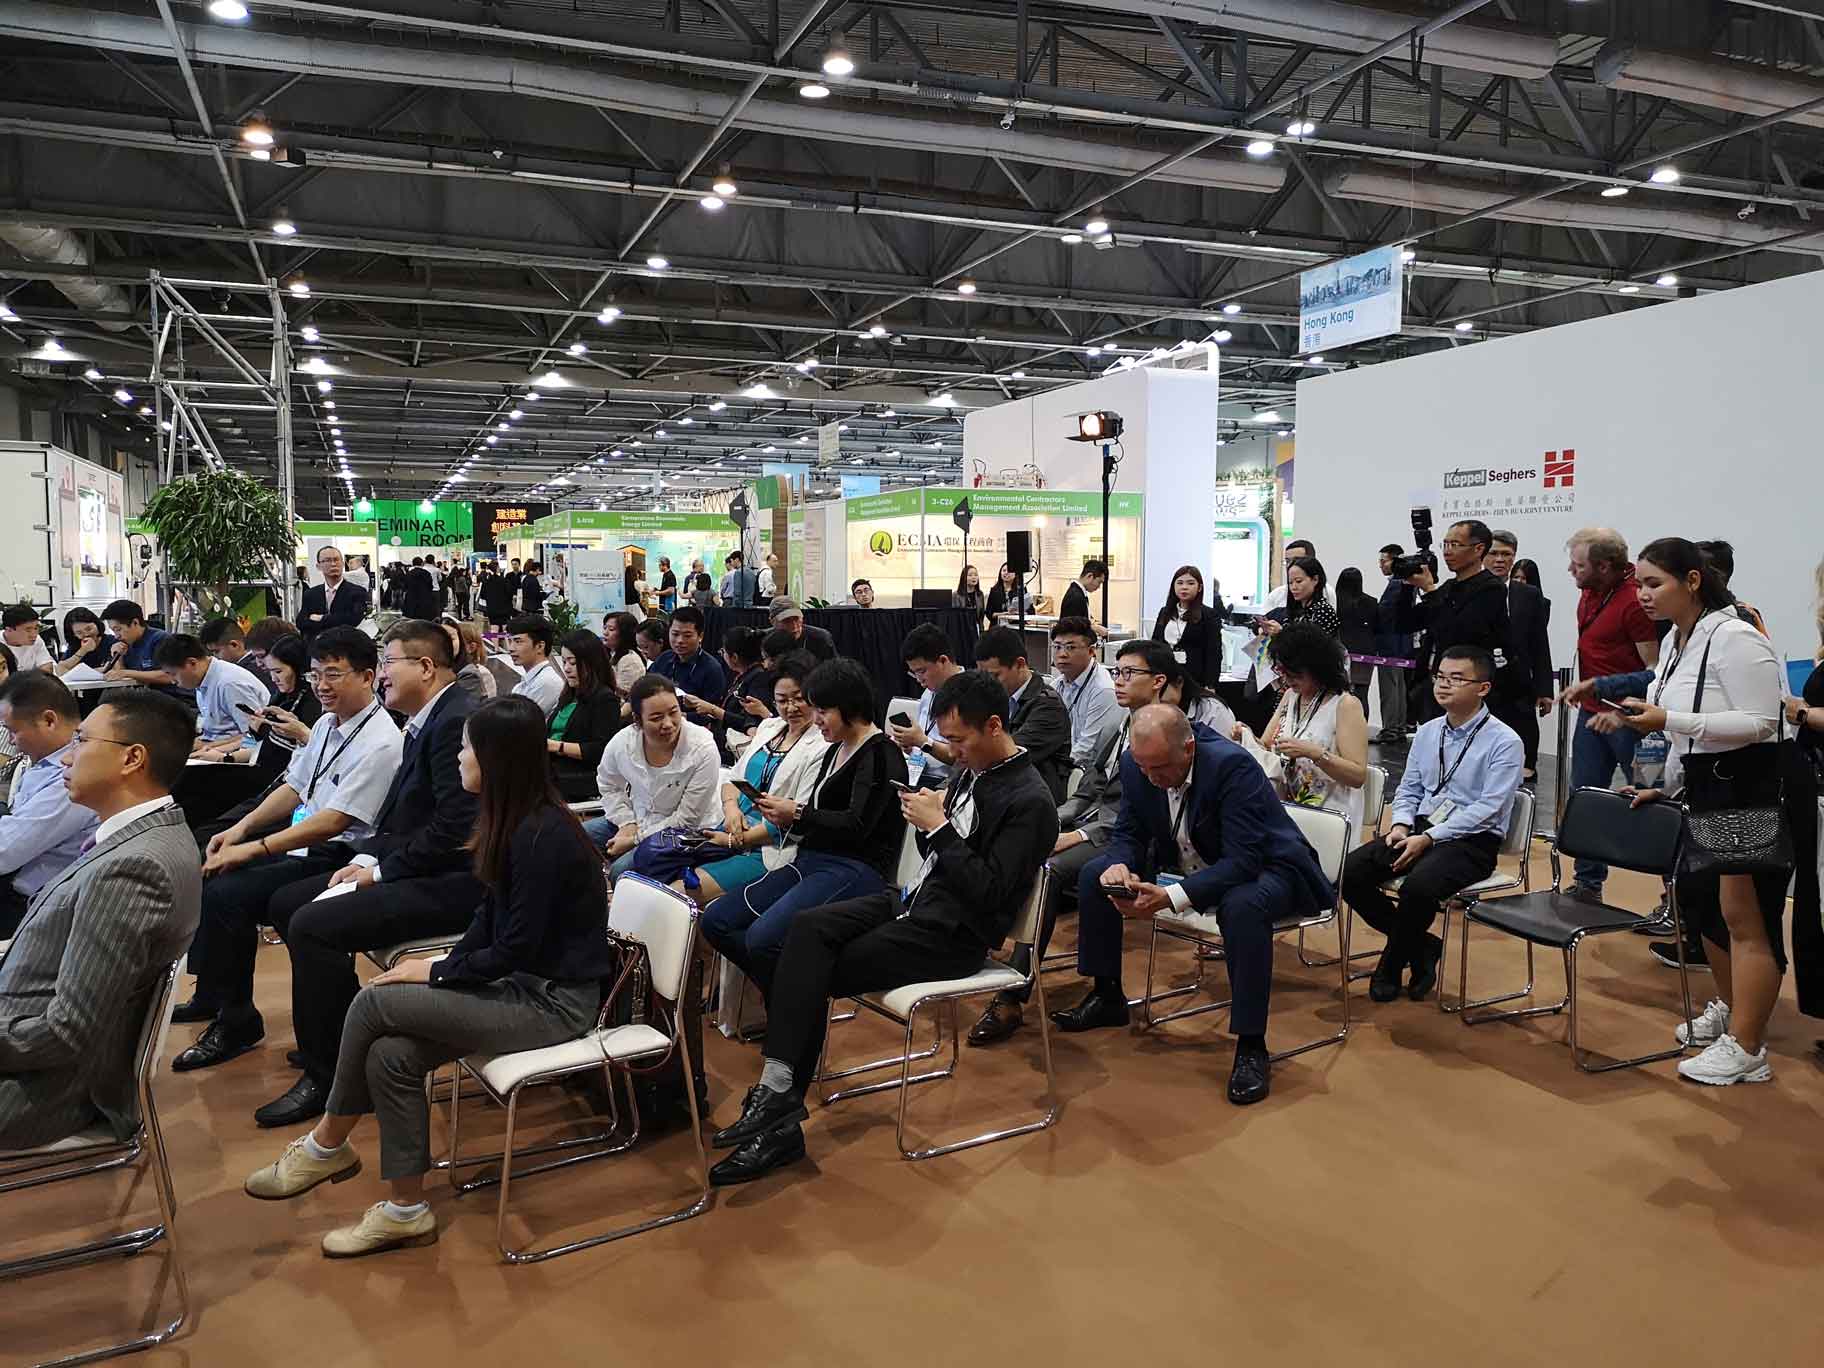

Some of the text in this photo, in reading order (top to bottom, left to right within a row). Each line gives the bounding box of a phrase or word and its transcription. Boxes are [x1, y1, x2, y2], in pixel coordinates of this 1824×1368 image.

[1304, 309, 1354, 330] Hong Kong
[1444, 468, 1537, 488] Keppel Seghers
[973, 494, 1065, 503] Environmental Contractors
[972, 503, 1089, 513] Management Association Limited
[366, 518, 446, 532] EMINAR
